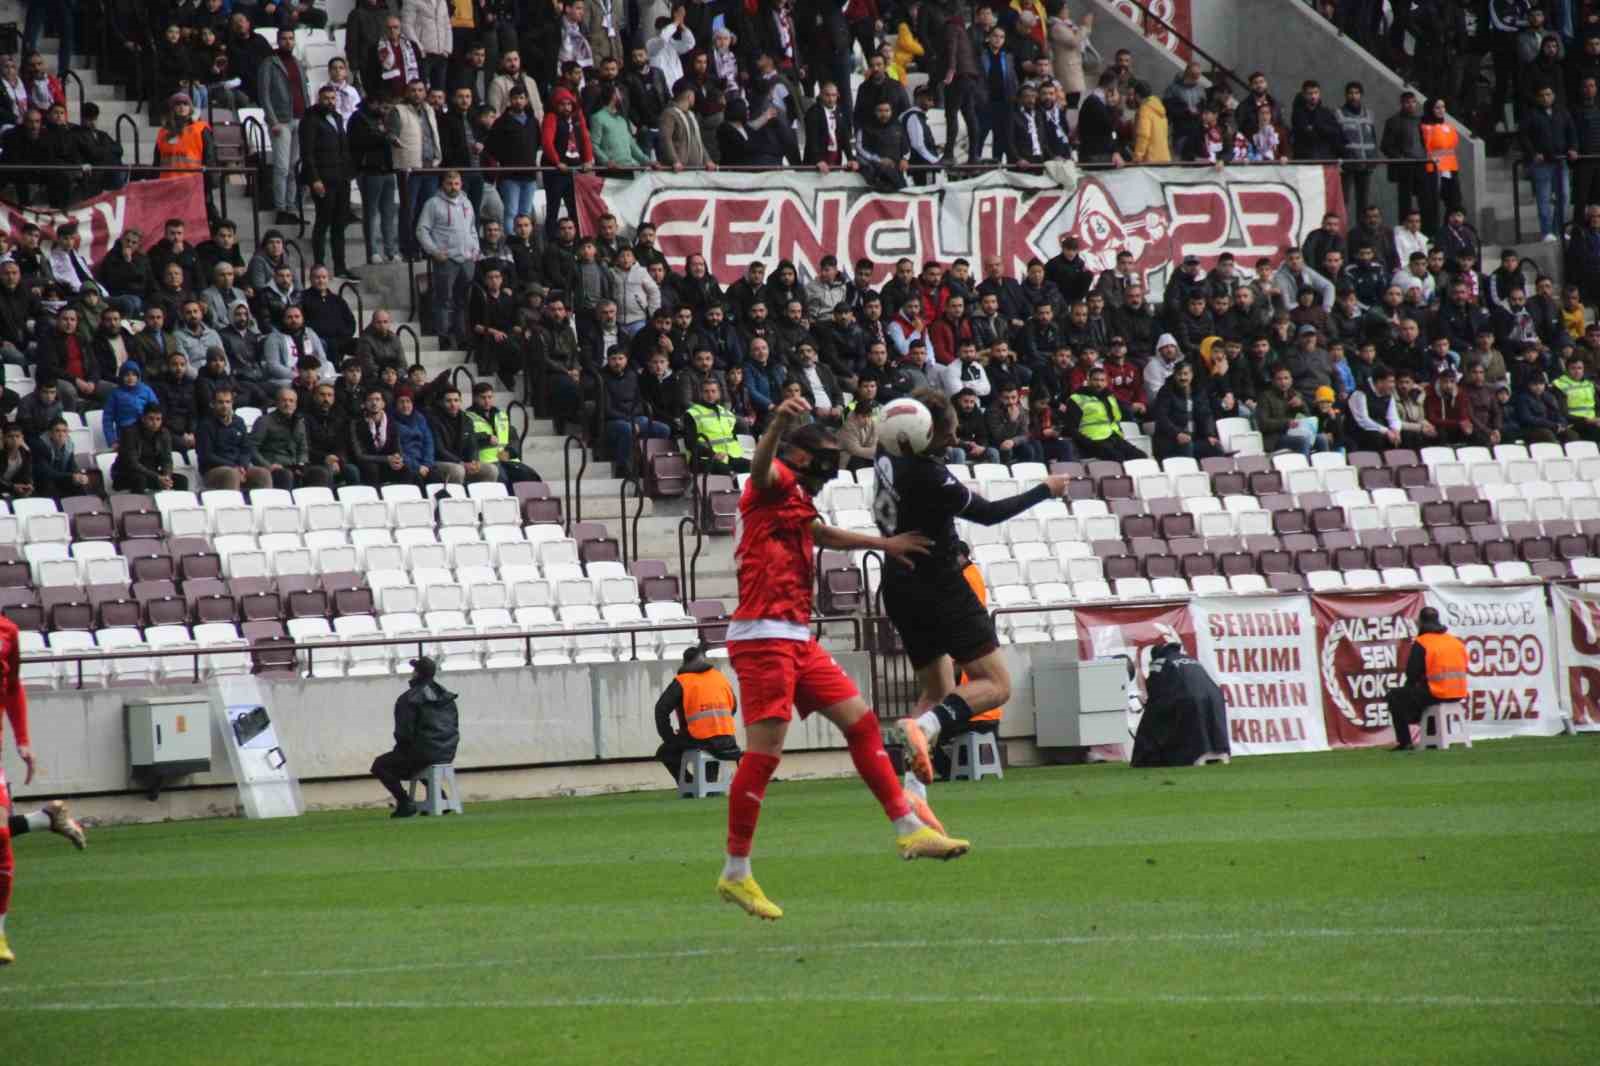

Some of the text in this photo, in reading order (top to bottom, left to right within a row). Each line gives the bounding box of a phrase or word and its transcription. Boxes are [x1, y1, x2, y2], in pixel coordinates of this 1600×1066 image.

[1208, 609, 1301, 641] ŞEHRİN
[1449, 602, 1536, 626] SADECE
[1213, 647, 1300, 673] TAKIMI
[1361, 645, 1397, 669] SEN
[1457, 634, 1544, 677] ORDO
[1221, 679, 1308, 708] ALEMİN
[1365, 702, 1393, 727] SE
[1231, 717, 1306, 743] KRALI
